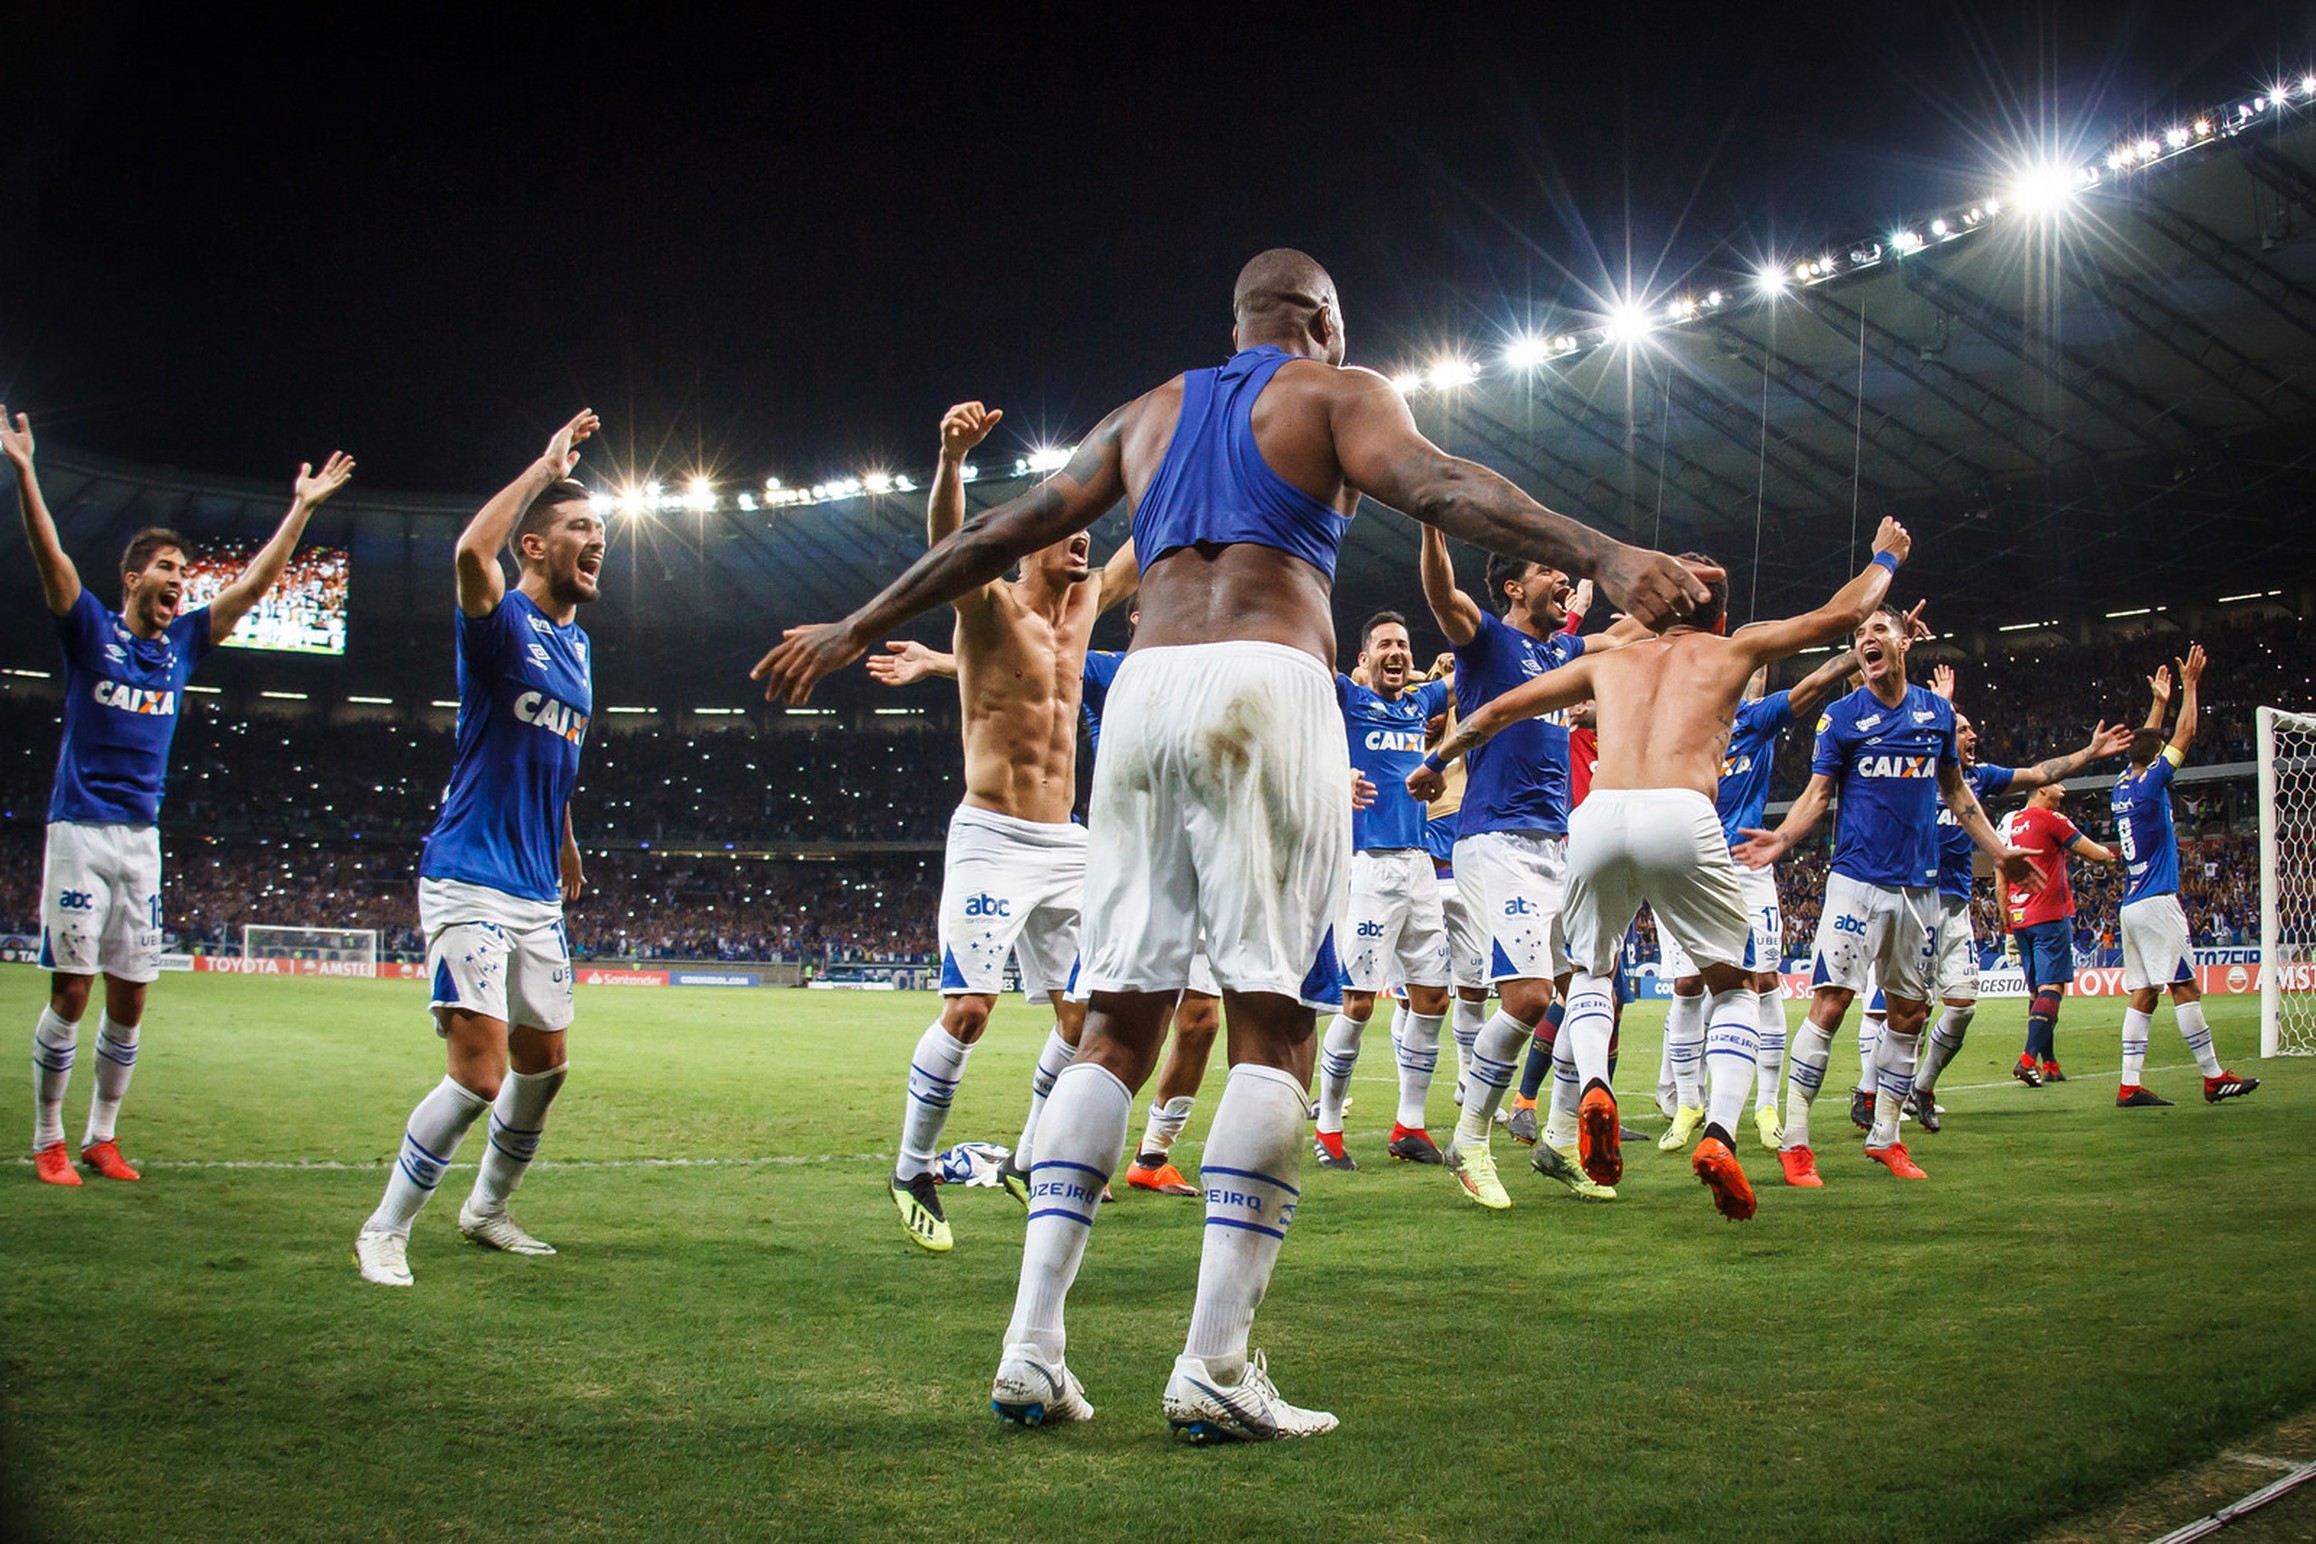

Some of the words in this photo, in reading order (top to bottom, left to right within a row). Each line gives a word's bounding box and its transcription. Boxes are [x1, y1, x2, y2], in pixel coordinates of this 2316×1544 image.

[94, 680, 175, 715] CAIXA
[514, 691, 589, 747] CAIX
[1858, 756, 1937, 778] CAIXA
[60, 889, 93, 910] abc
[966, 893, 1011, 917] abc
[1834, 914, 1868, 937] abc
[205, 956, 279, 975] TOYOTA
[604, 972, 662, 986] Santander
